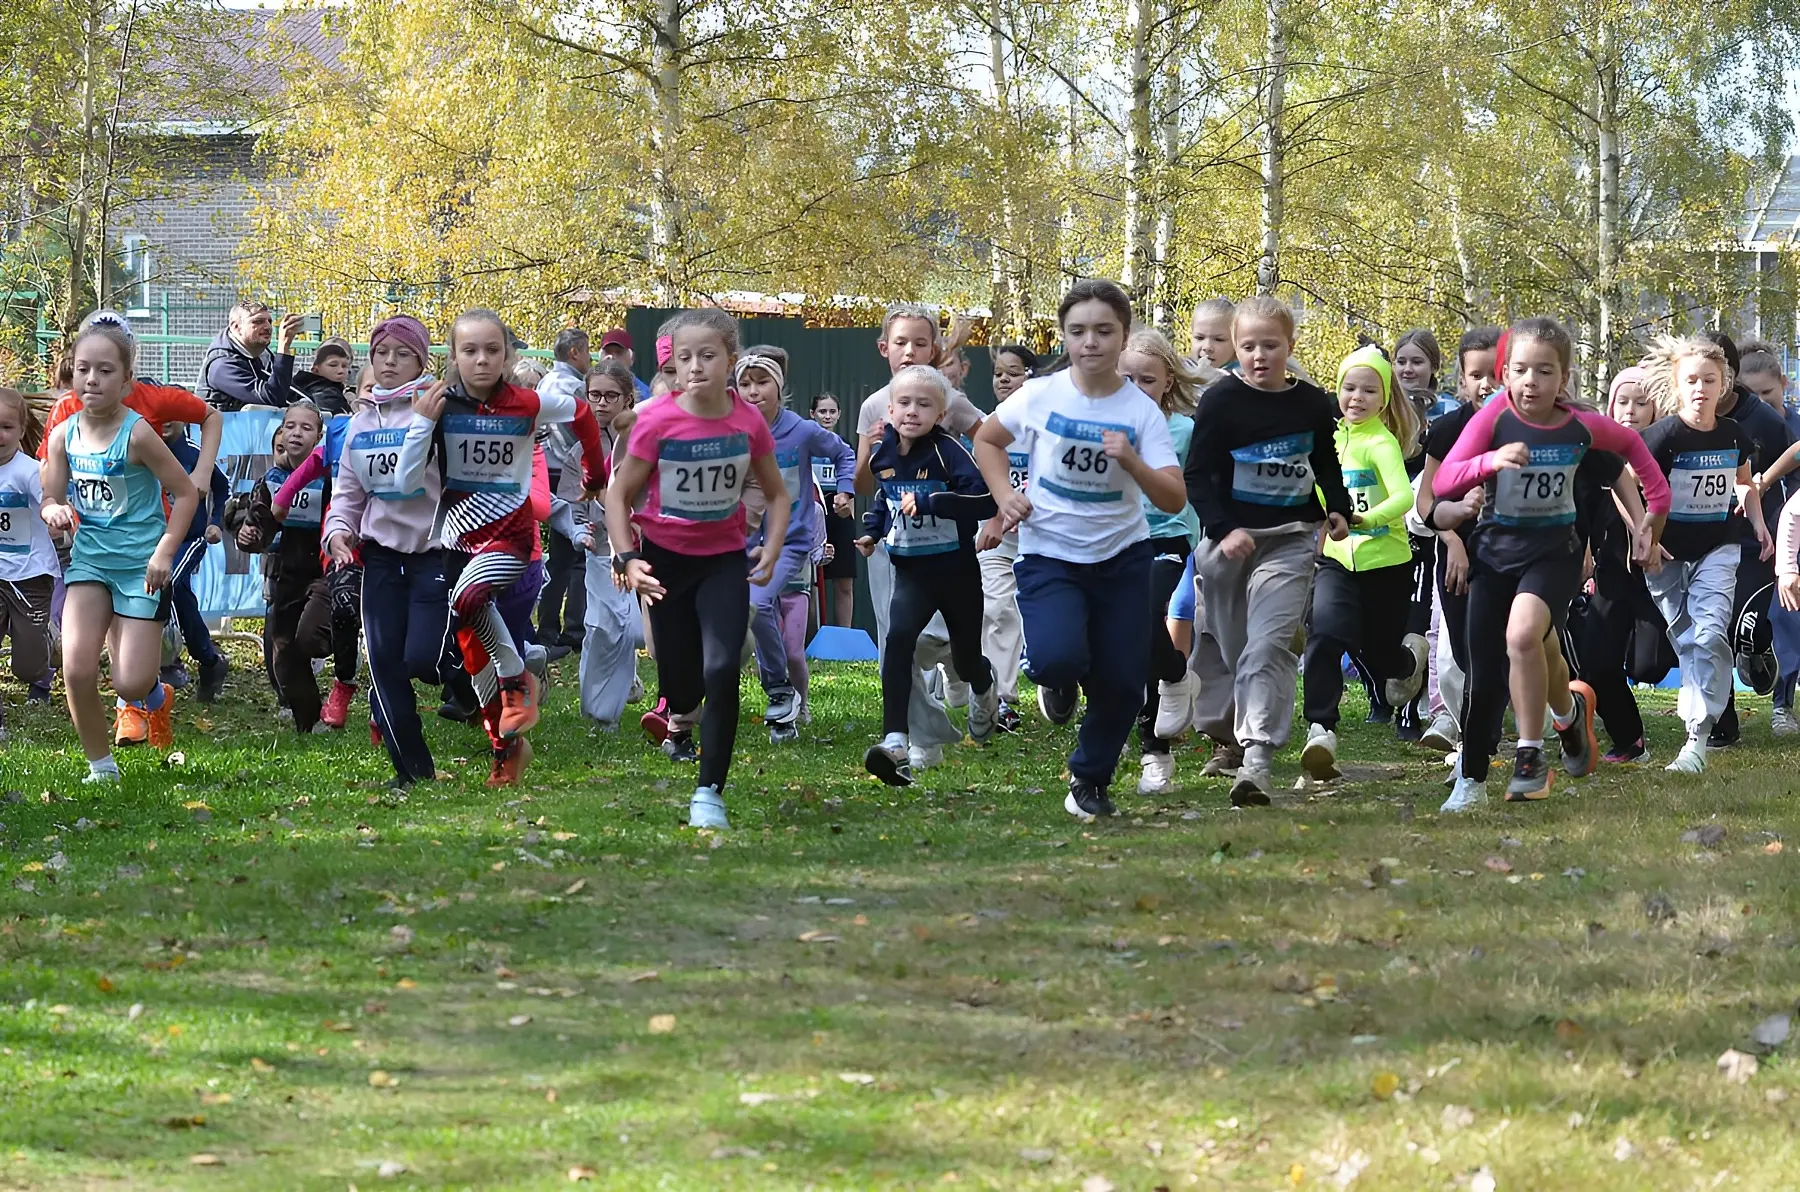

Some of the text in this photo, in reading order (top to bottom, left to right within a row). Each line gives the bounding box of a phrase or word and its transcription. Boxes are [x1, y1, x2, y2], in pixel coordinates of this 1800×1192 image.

[458, 440, 513, 465] 1558
[1061, 445, 1108, 474] 436
[676, 463, 737, 492] 2179
[1521, 472, 1566, 499] 783
[1691, 474, 1727, 497] 759
